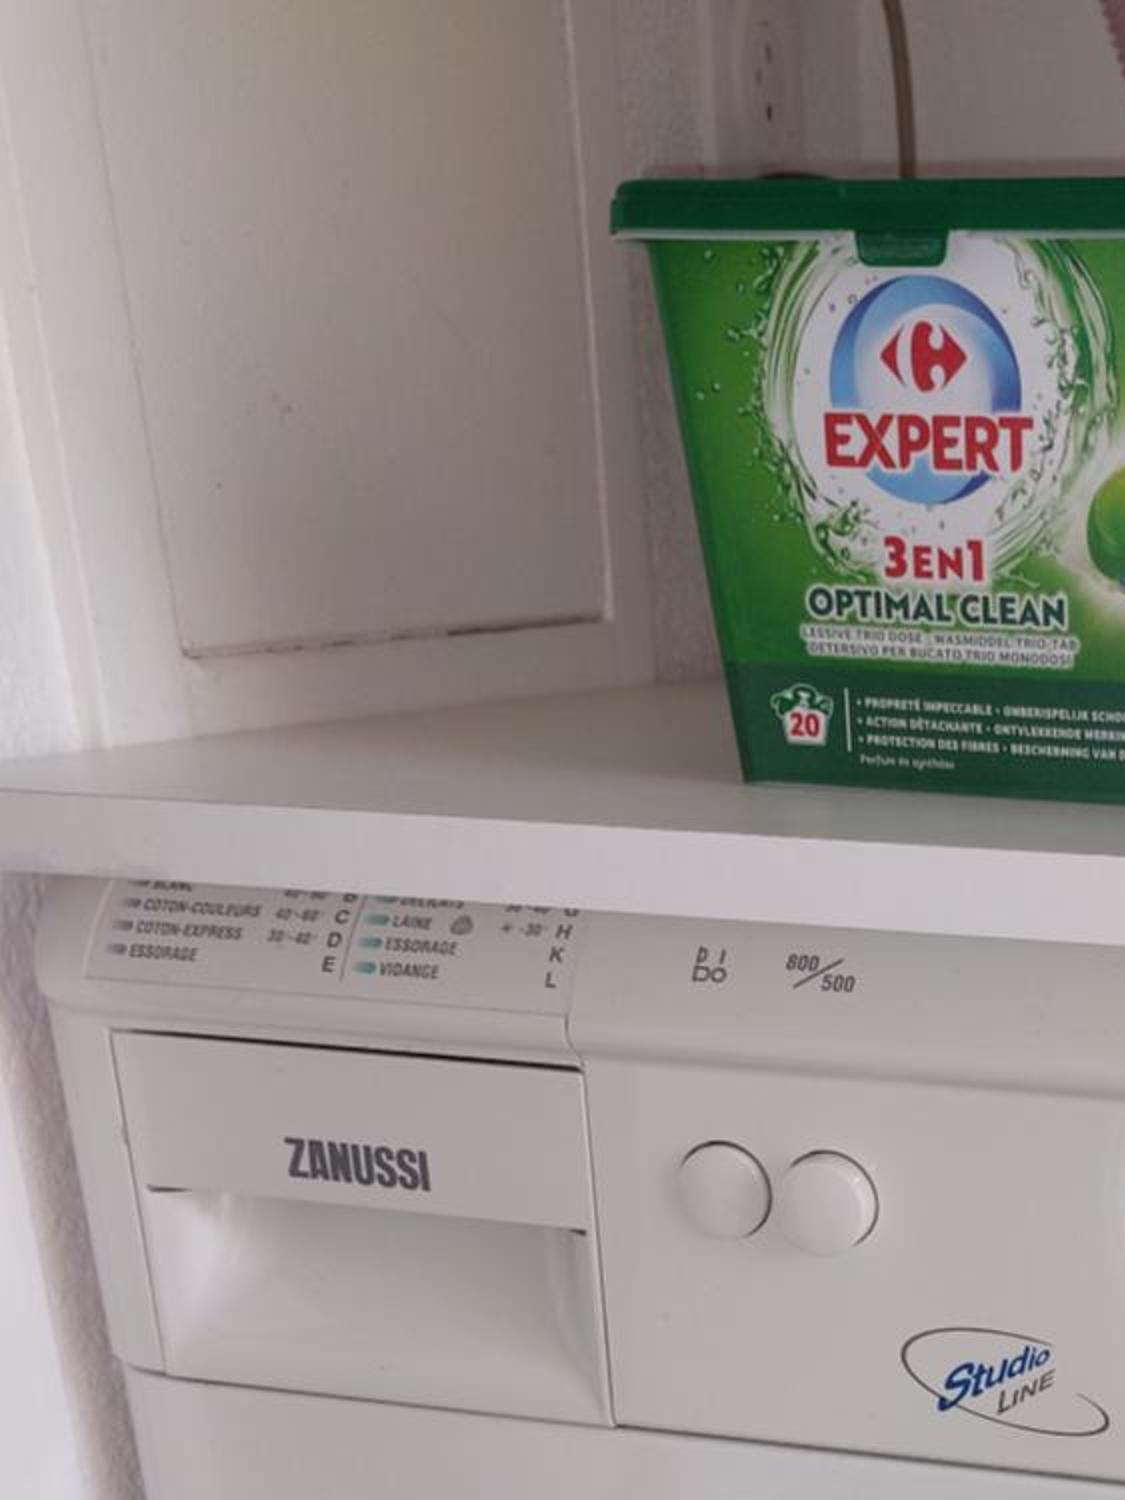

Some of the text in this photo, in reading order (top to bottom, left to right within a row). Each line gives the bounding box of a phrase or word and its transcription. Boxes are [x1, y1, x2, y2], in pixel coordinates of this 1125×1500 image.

[823, 412, 1034, 472] EXPERT
[883, 535, 985, 582] 3EN1
[808, 587, 1065, 627] OPTIMAL CLEAN
[856, 628, 885, 641] TRIO
[935, 634, 1012, 649] WASMIDDEL
[882, 645, 906, 658] PER
[910, 646, 964, 661] BUCATO
[966, 649, 996, 663] TRIO
[864, 697, 920, 712] PROPRETÉ
[922, 701, 993, 716] IMPECCABLE
[790, 712, 819, 737] 20
[866, 716, 908, 729] ACTION
[909, 717, 982, 734] DÉTACHANTE
[866, 735, 937, 749] PROTECTION
[937, 739, 959, 751] DES
[960, 740, 1000, 753] FIBRES
[1010, 743, 1090, 759] BESCHERMING
[1092, 748, 1117, 761] VAN
[143, 898, 263, 918] COTON-COULEURS
[335, 908, 351, 925] C
[136, 919, 244, 941] COTON-EXPRESS
[327, 931, 343, 948] D
[391, 915, 433, 931] LAINE
[554, 923, 574, 940] H
[128, 943, 337, 973] ESSORAGE E
[384, 937, 565, 963] ESSORAGE K
[379, 961, 557, 989] VIDANGE L
[284, 1136, 432, 1193] ZANUSSI
[937, 1345, 1056, 1415] Studio LINE
